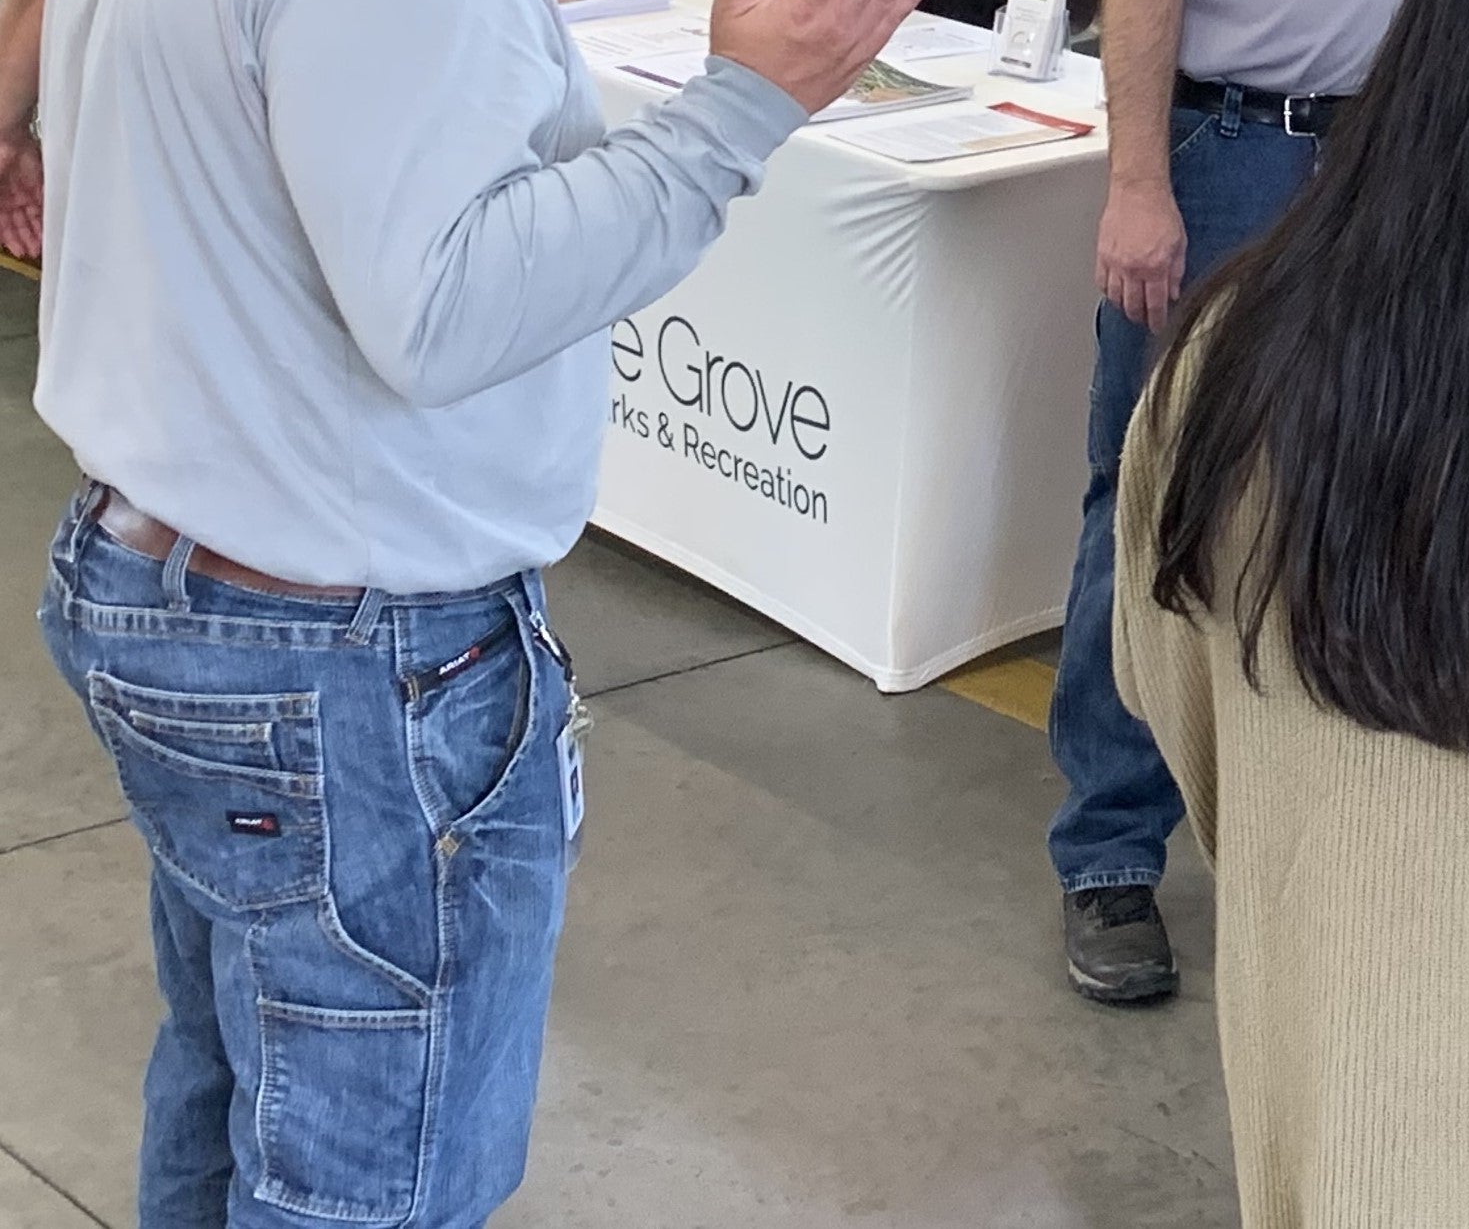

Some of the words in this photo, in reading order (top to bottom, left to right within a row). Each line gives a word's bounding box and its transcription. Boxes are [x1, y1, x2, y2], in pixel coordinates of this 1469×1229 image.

[658, 315, 830, 461] Grove
[657, 412, 675, 451] &
[684, 422, 828, 524] Recreation
[439, 651, 470, 675] ARIAT
